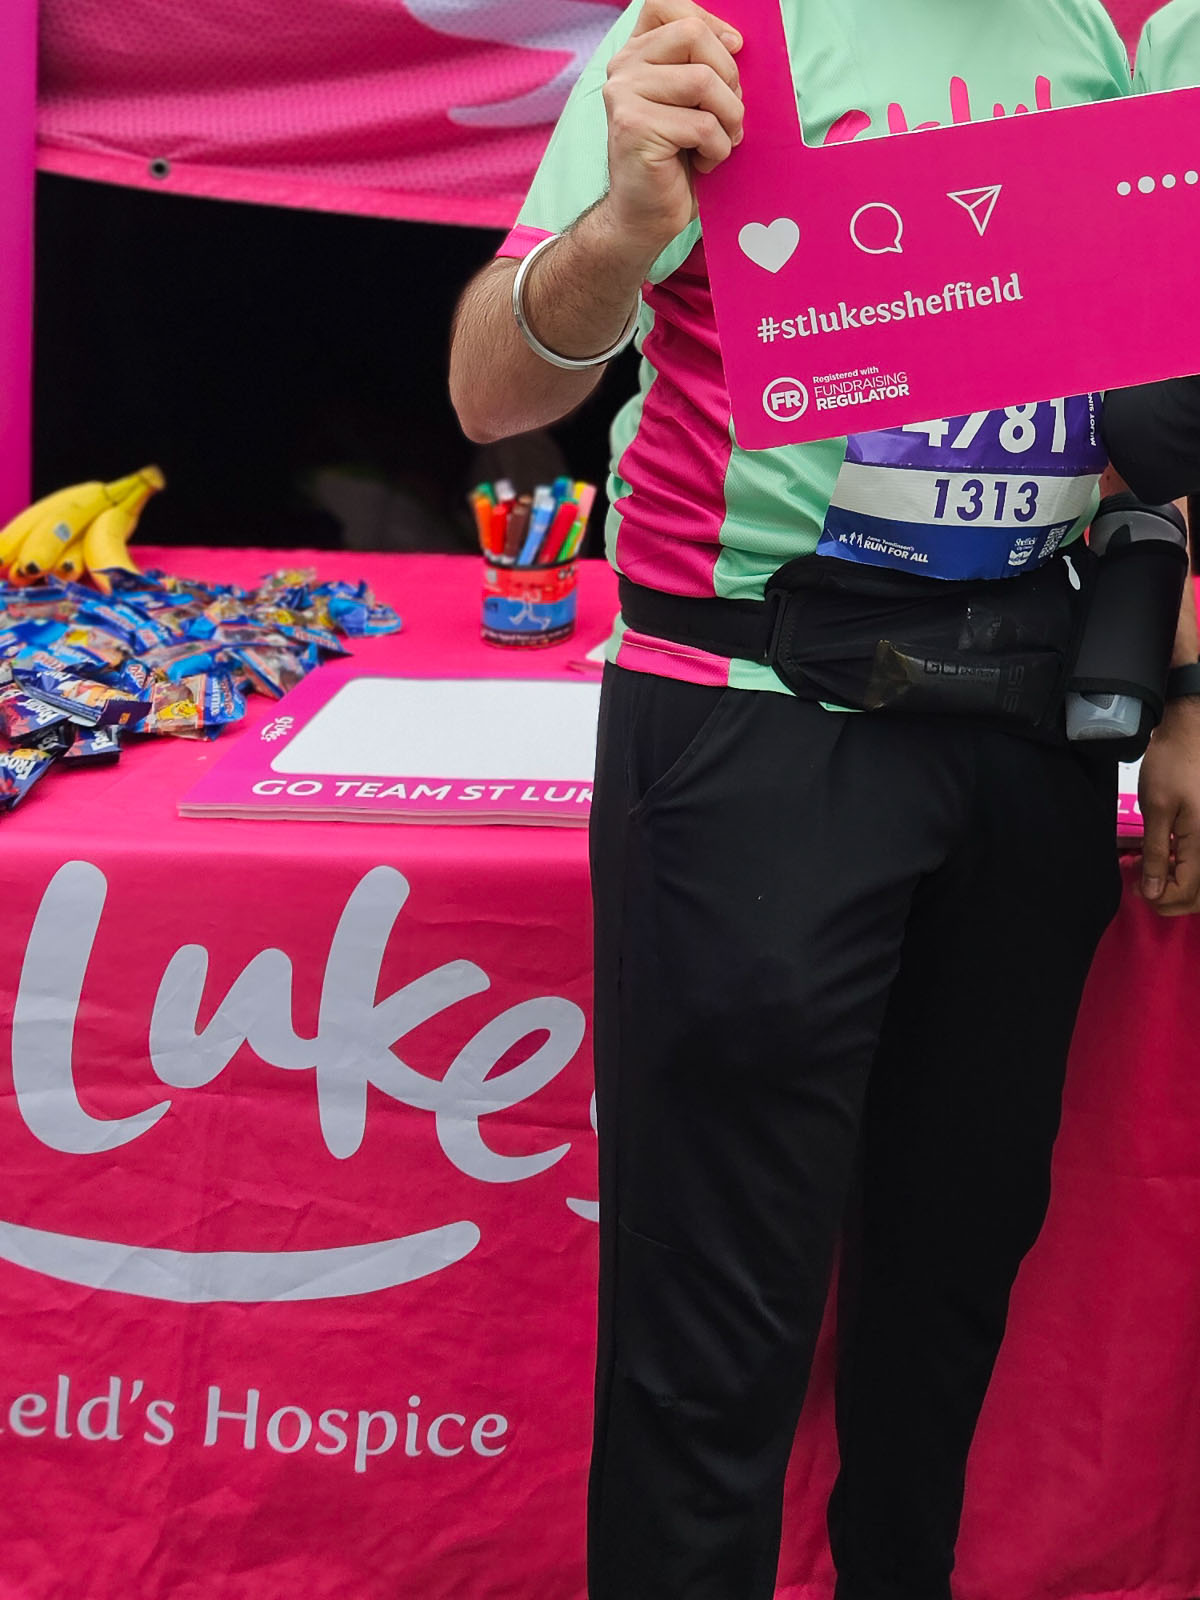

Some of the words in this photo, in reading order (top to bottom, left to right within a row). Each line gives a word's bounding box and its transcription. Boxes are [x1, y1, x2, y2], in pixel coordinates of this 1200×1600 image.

[757, 272, 1023, 344] #stlukessheffield
[813, 369, 859, 384] Registered
[859, 366, 880, 376] with
[814, 371, 908, 398] FUNDRAISING
[770, 390, 802, 411] FR
[815, 384, 910, 411] REGULATOR
[933, 478, 1040, 523] 1313
[863, 539, 887, 553] RUN
[887, 546, 909, 560] FOR
[909, 552, 929, 563] ALL
[251, 779, 323, 797] GO
[334, 780, 453, 801] TEAM
[457, 784, 516, 801] ST
[519, 785, 594, 803] LUK
[0, 1375, 175, 1447] eld's
[203, 1385, 509, 1473] Hospice
